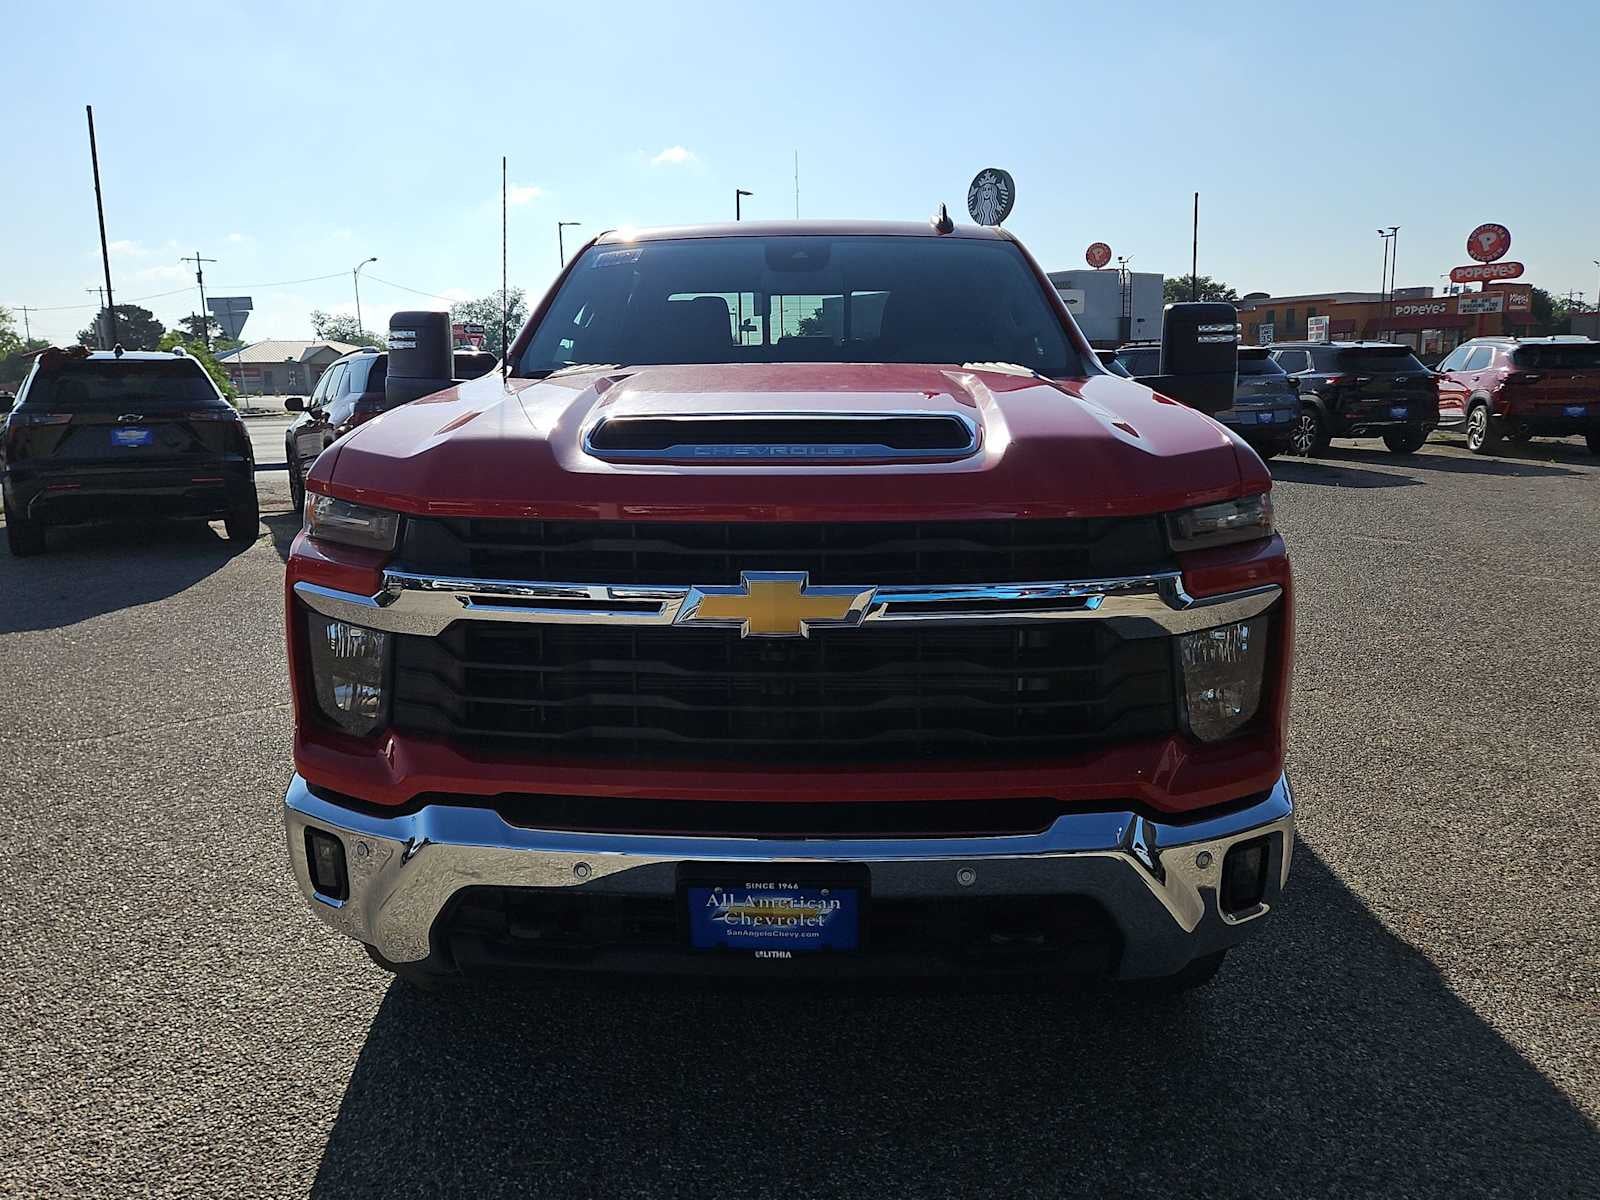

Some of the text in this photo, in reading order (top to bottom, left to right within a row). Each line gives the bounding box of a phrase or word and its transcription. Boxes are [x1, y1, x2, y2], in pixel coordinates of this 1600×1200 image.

[694, 446, 860, 456] CHEVROLET
[745, 882, 775, 890] SINCE
[706, 893, 841, 910] All American
[723, 910, 826, 928] Chevrolet
[726, 929, 820, 938] SanAngeloChevy.com
